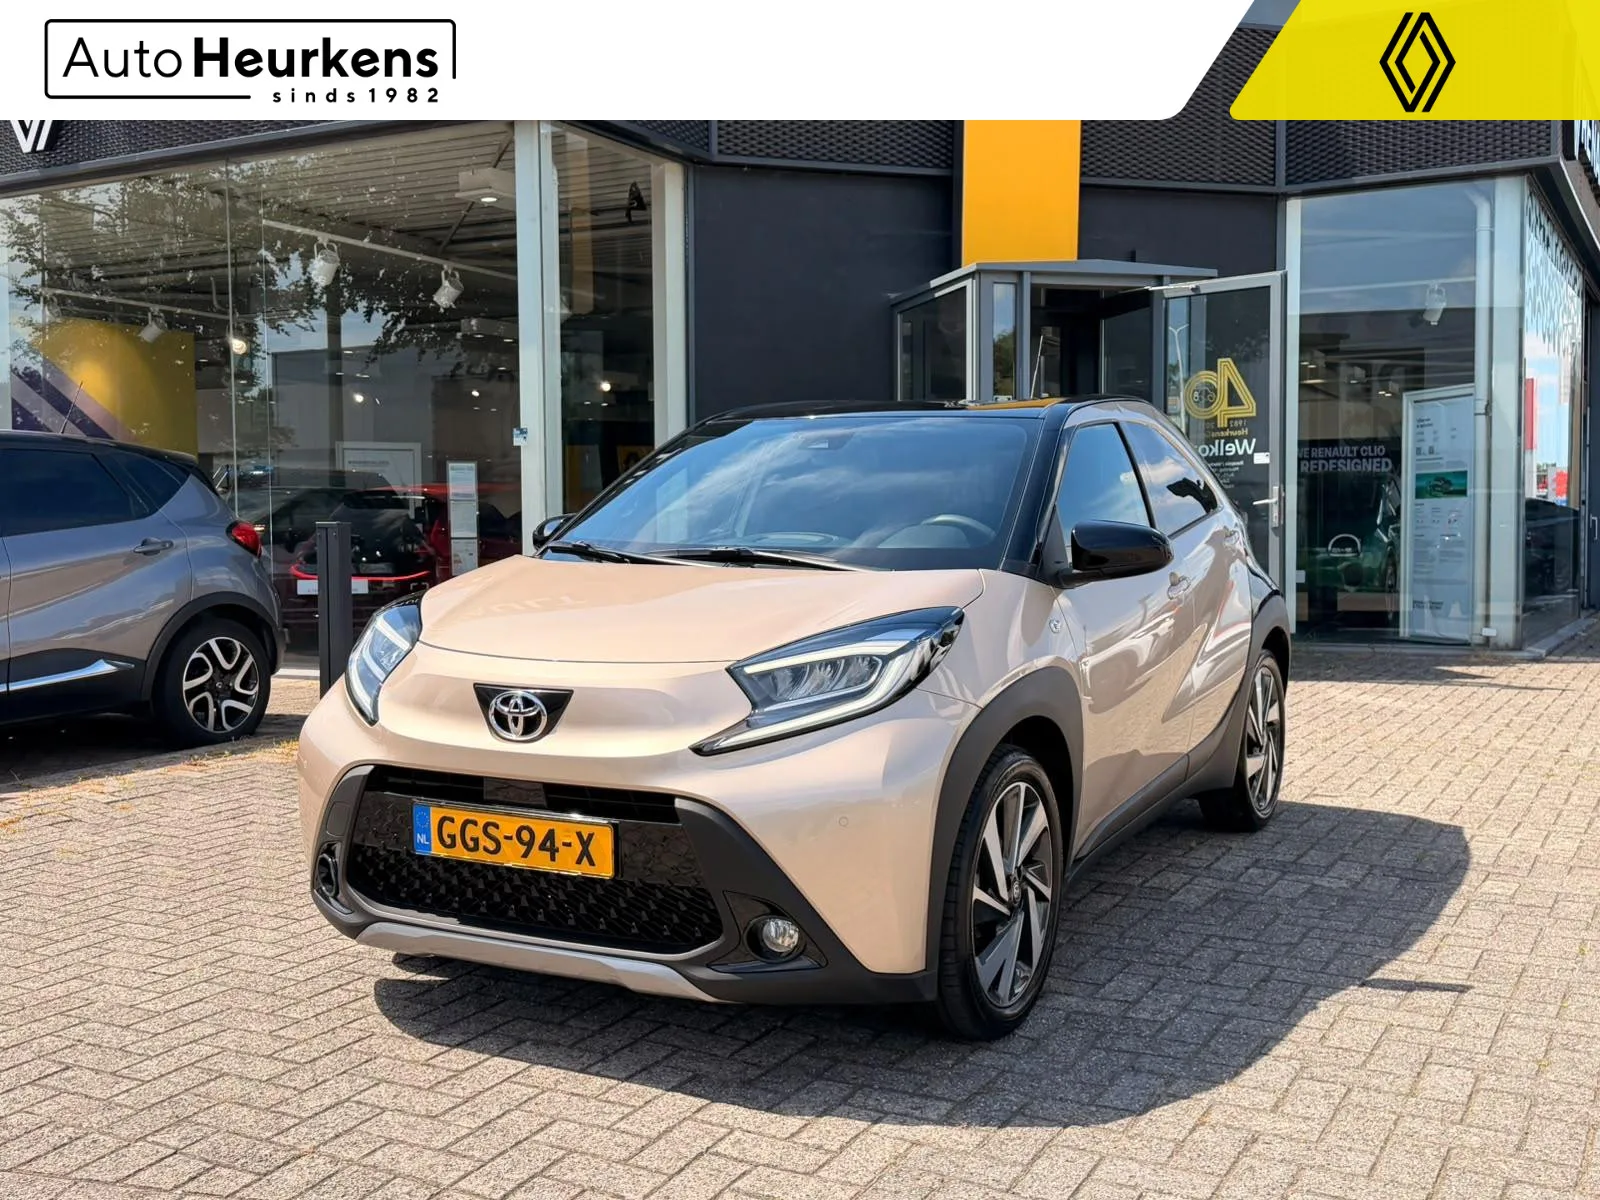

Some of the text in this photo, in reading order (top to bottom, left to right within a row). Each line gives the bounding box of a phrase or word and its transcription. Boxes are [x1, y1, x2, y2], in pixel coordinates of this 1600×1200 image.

[1311, 446, 1359, 458] RENAULT
[1360, 445, 1386, 457] CLIO
[1300, 457, 1393, 473] REDESIGNED
[416, 834, 430, 845] NL
[437, 815, 596, 867] GGS-94-X
